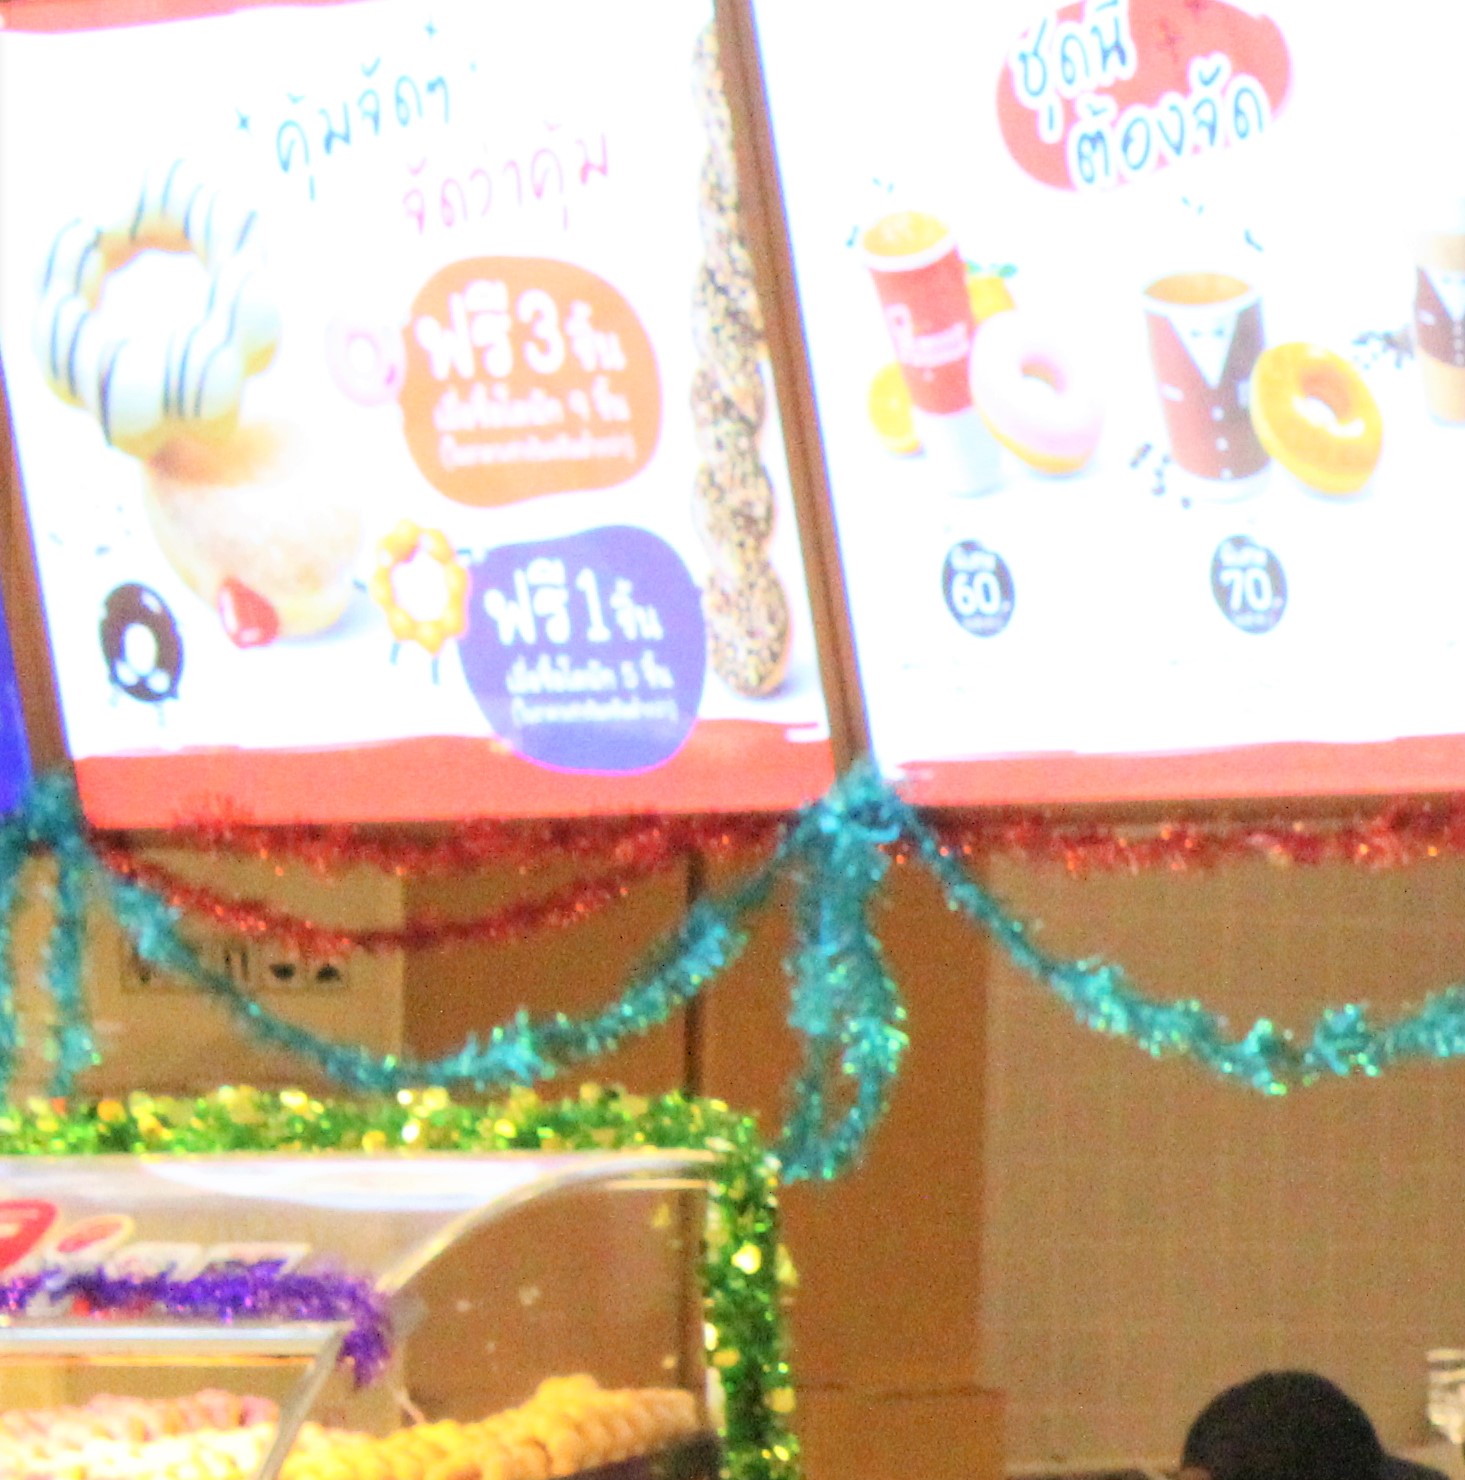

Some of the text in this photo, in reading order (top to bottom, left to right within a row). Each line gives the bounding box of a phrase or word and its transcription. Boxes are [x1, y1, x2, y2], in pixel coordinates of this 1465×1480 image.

[1017, 0, 1127, 132] ชุดนี
[1076, 62, 1264, 185] ต้องจัด
[274, 55, 451, 203] คุ้มจัดๆ
[401, 118, 608, 236] จัดว่าคุ้ม
[414, 278, 628, 383] ฟรี 3 ชิ้น
[482, 557, 665, 646] ฟรี 1 ชิ้น
